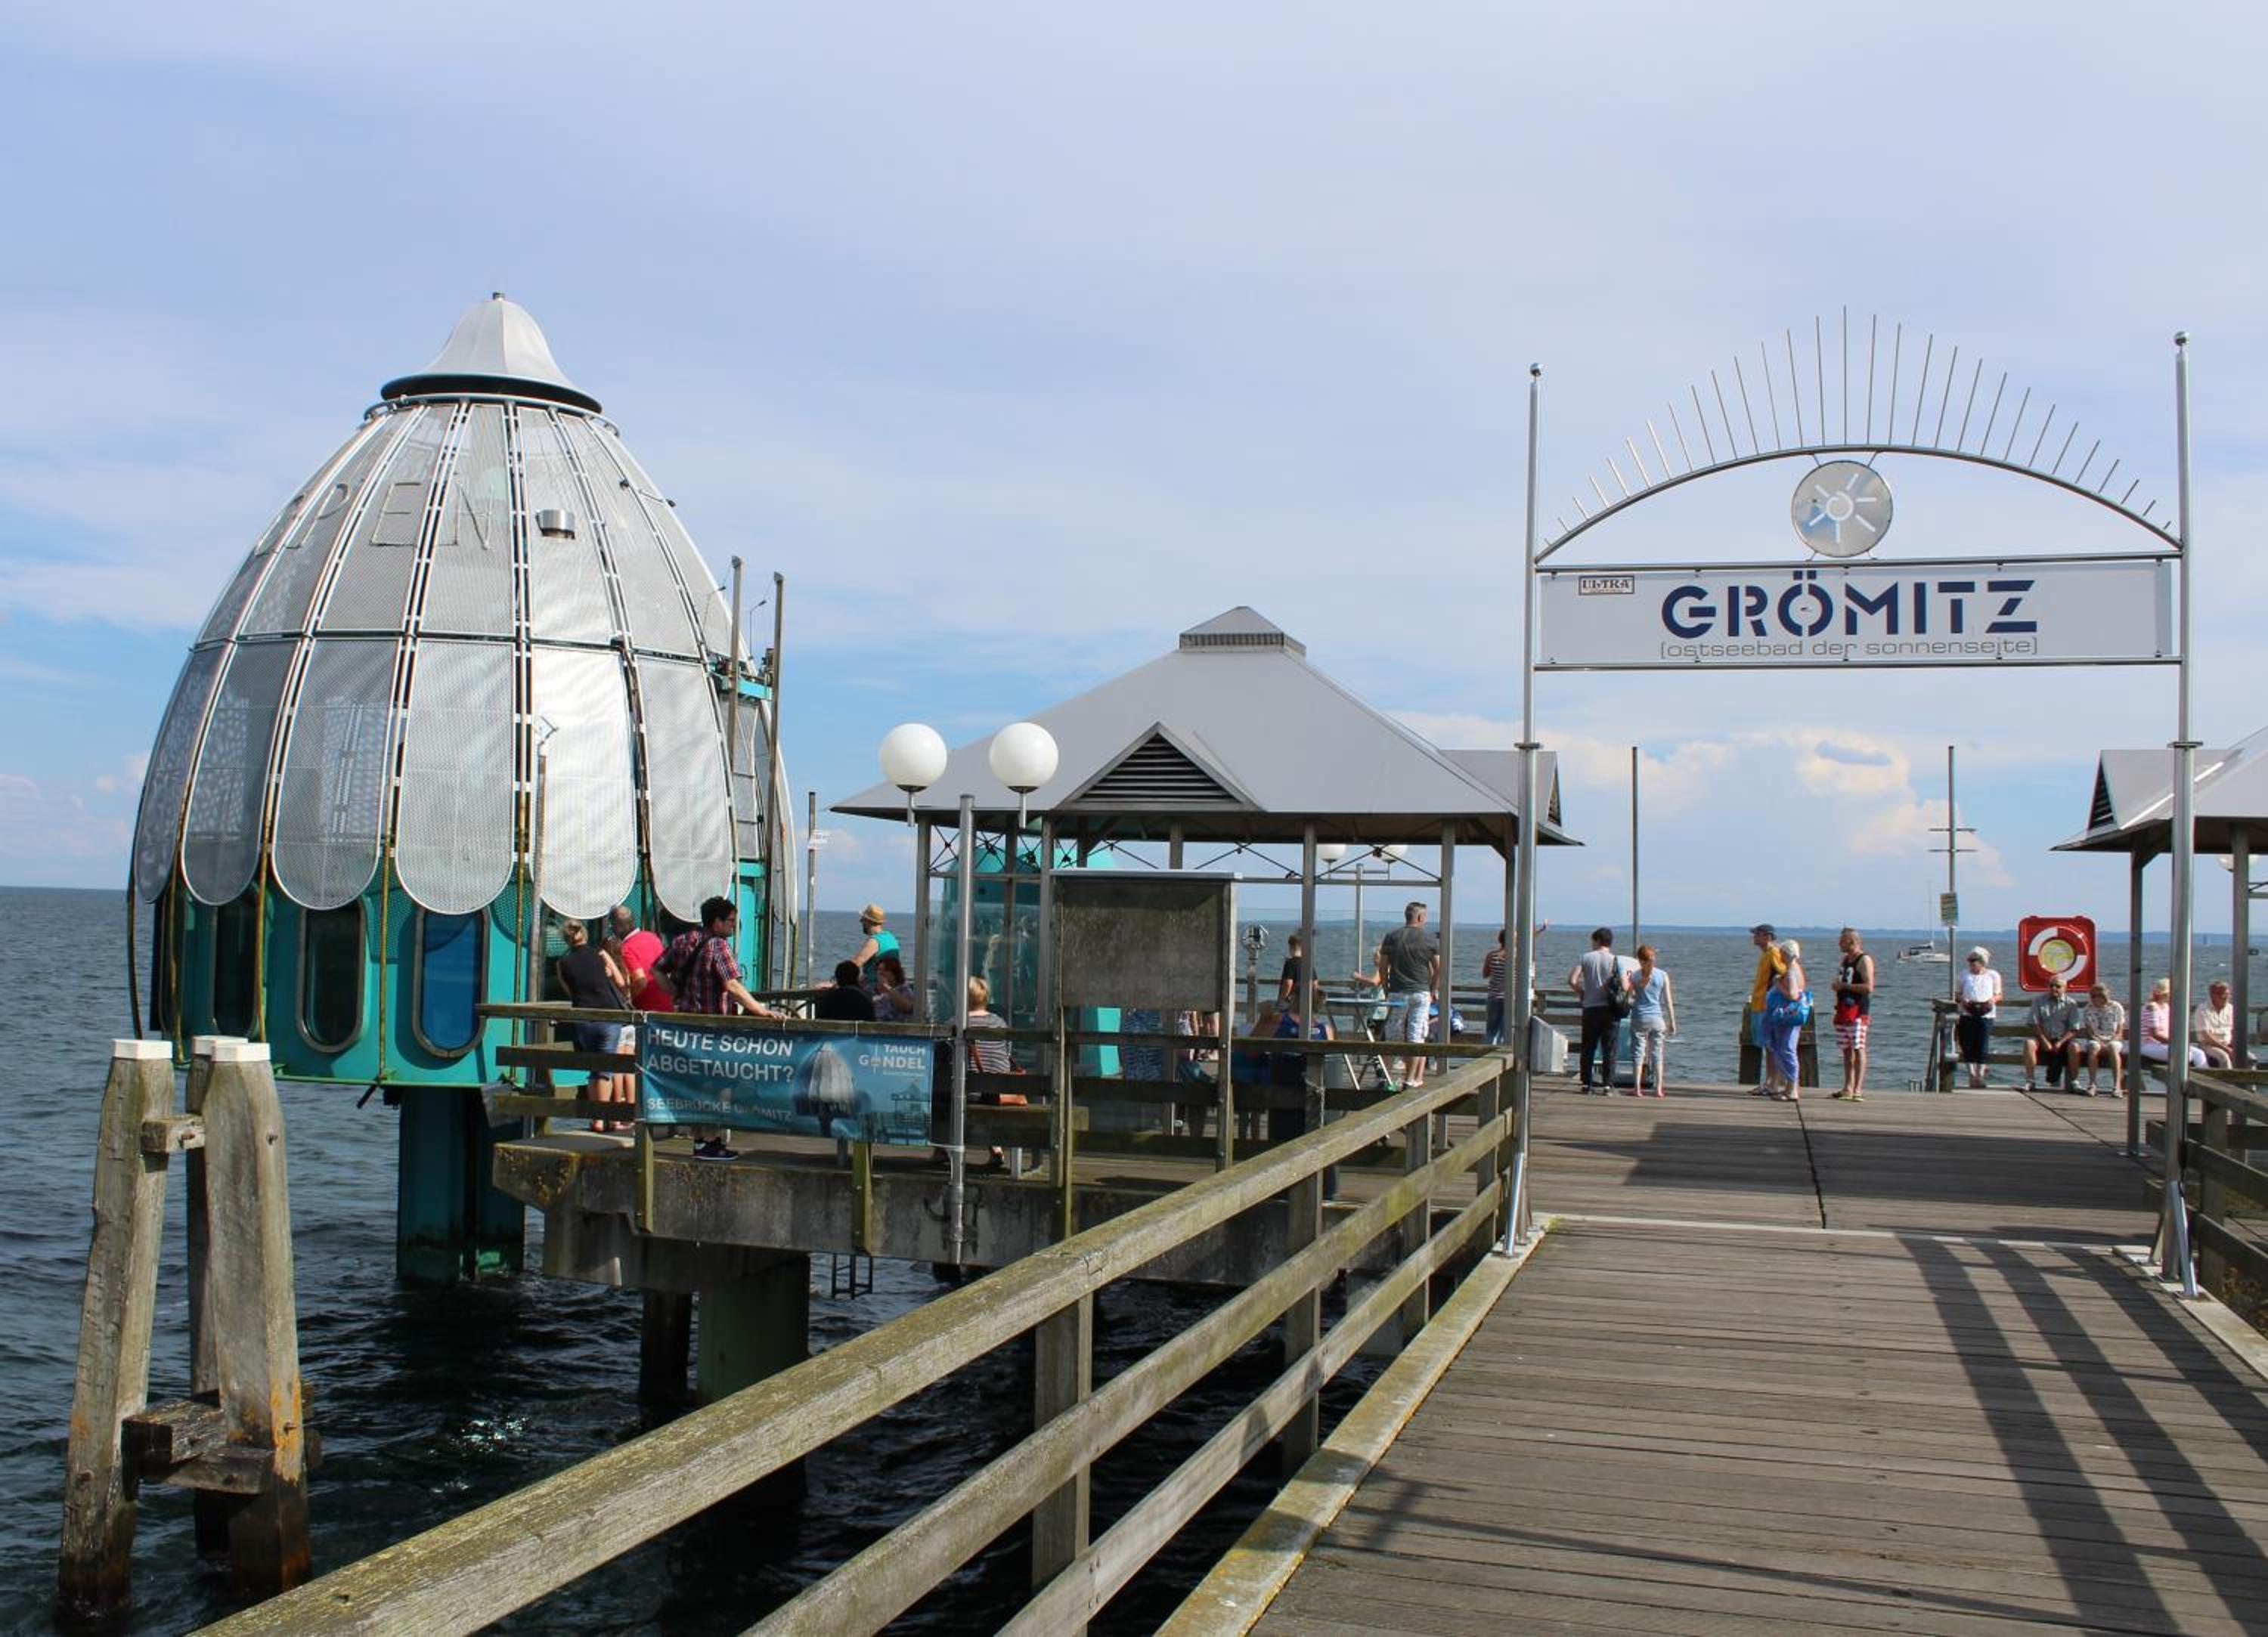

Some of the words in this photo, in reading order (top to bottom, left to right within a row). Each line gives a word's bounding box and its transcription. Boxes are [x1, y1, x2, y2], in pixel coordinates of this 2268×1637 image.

[1661, 570, 2037, 639] GRÖMITZ
[1813, 640, 1857, 656] der
[647, 1028, 714, 1051] HEUTE
[719, 1034, 793, 1057] SCHON
[883, 1044, 926, 1056] TAUCH
[646, 1054, 794, 1082] ABGETAUCHT?
